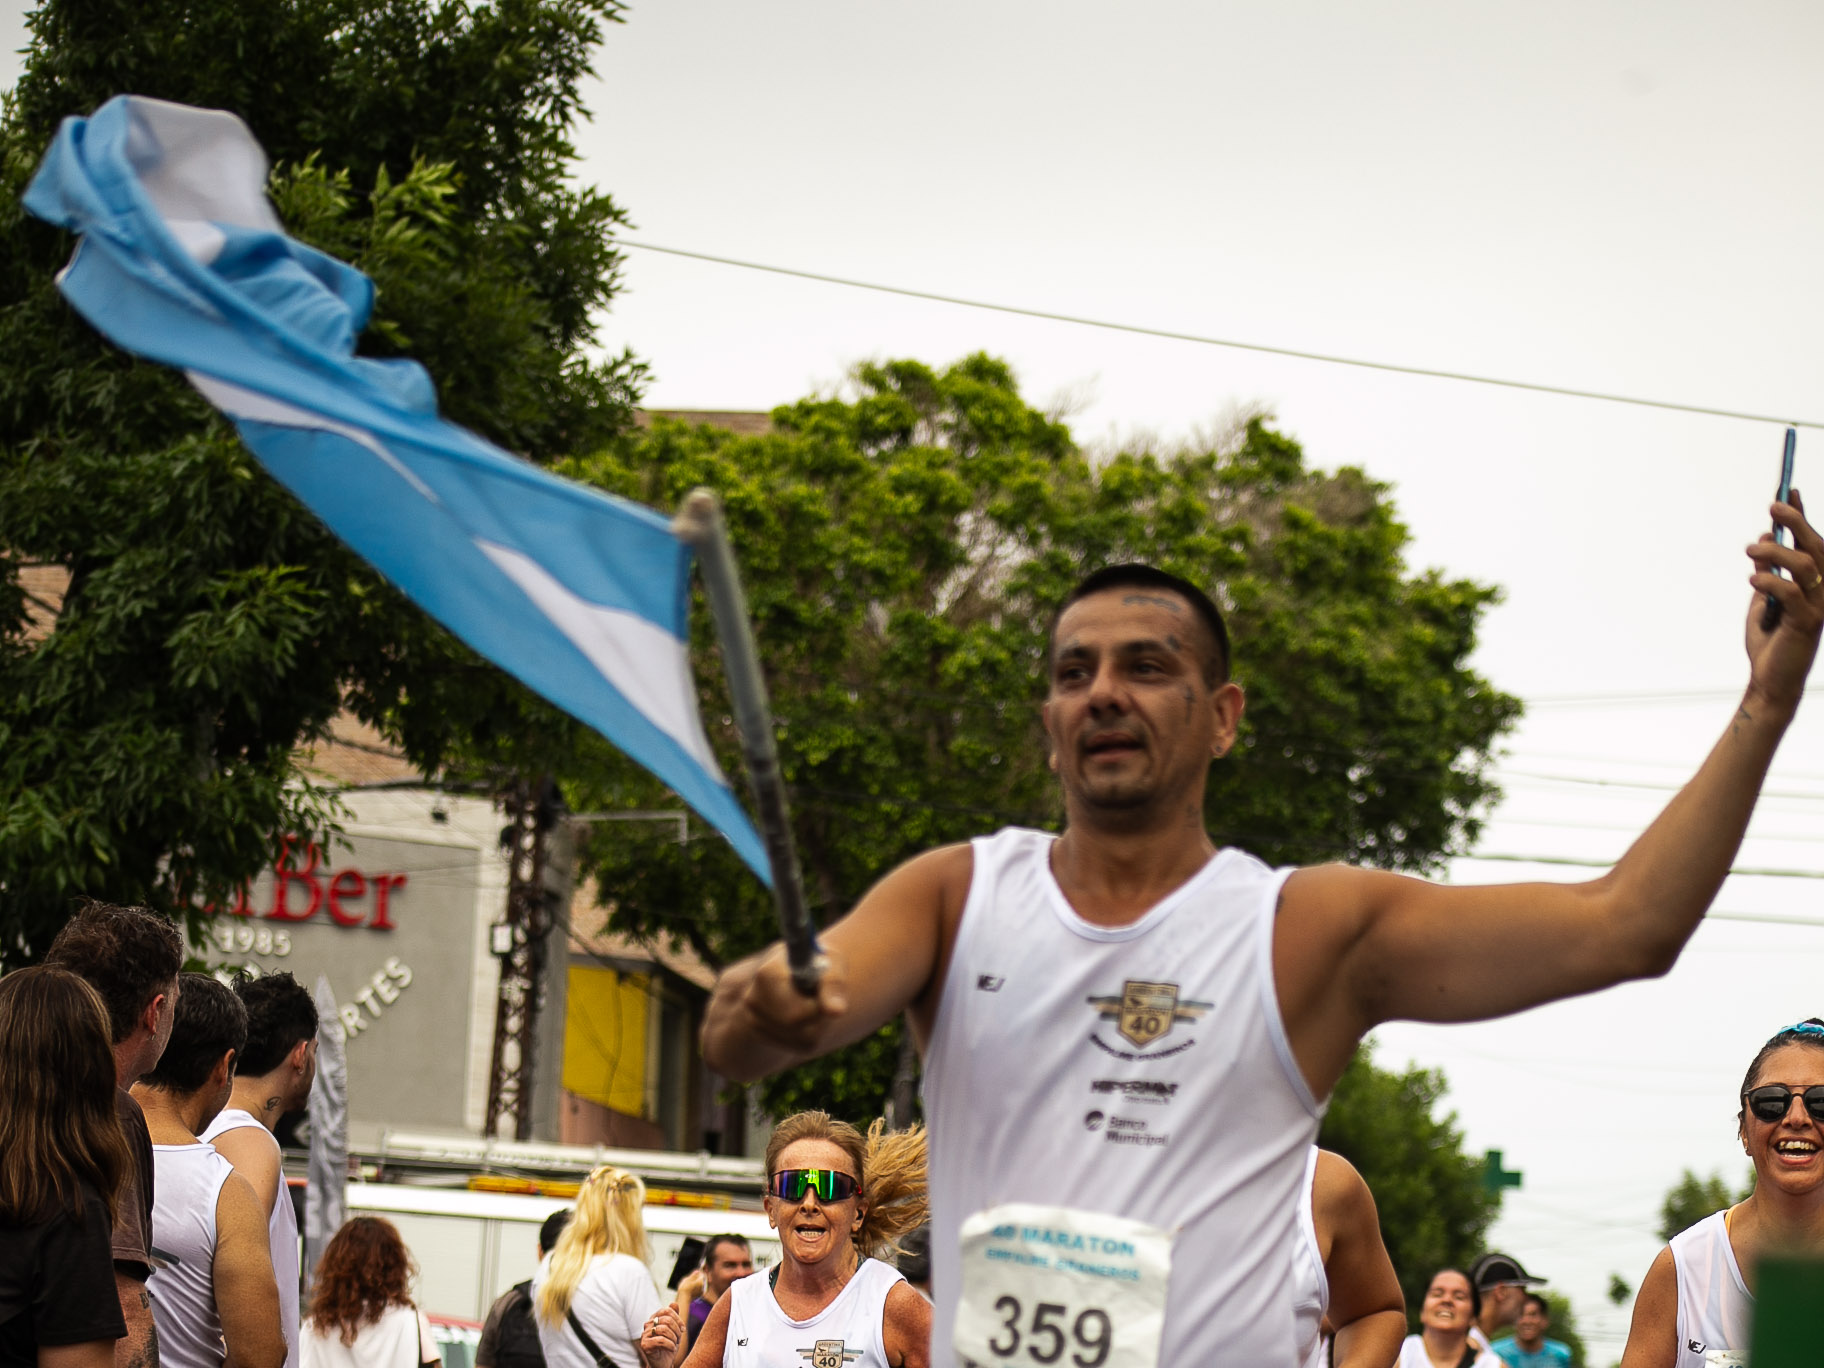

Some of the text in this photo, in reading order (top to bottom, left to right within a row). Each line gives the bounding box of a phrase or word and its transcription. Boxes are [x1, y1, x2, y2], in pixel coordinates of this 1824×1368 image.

[216, 925, 292, 957] 1985
[339, 955, 413, 1038] RTES
[1130, 1016, 1160, 1035] 40
[1688, 1339, 1706, 1354] NEJ
[819, 1357, 837, 1367] 40
